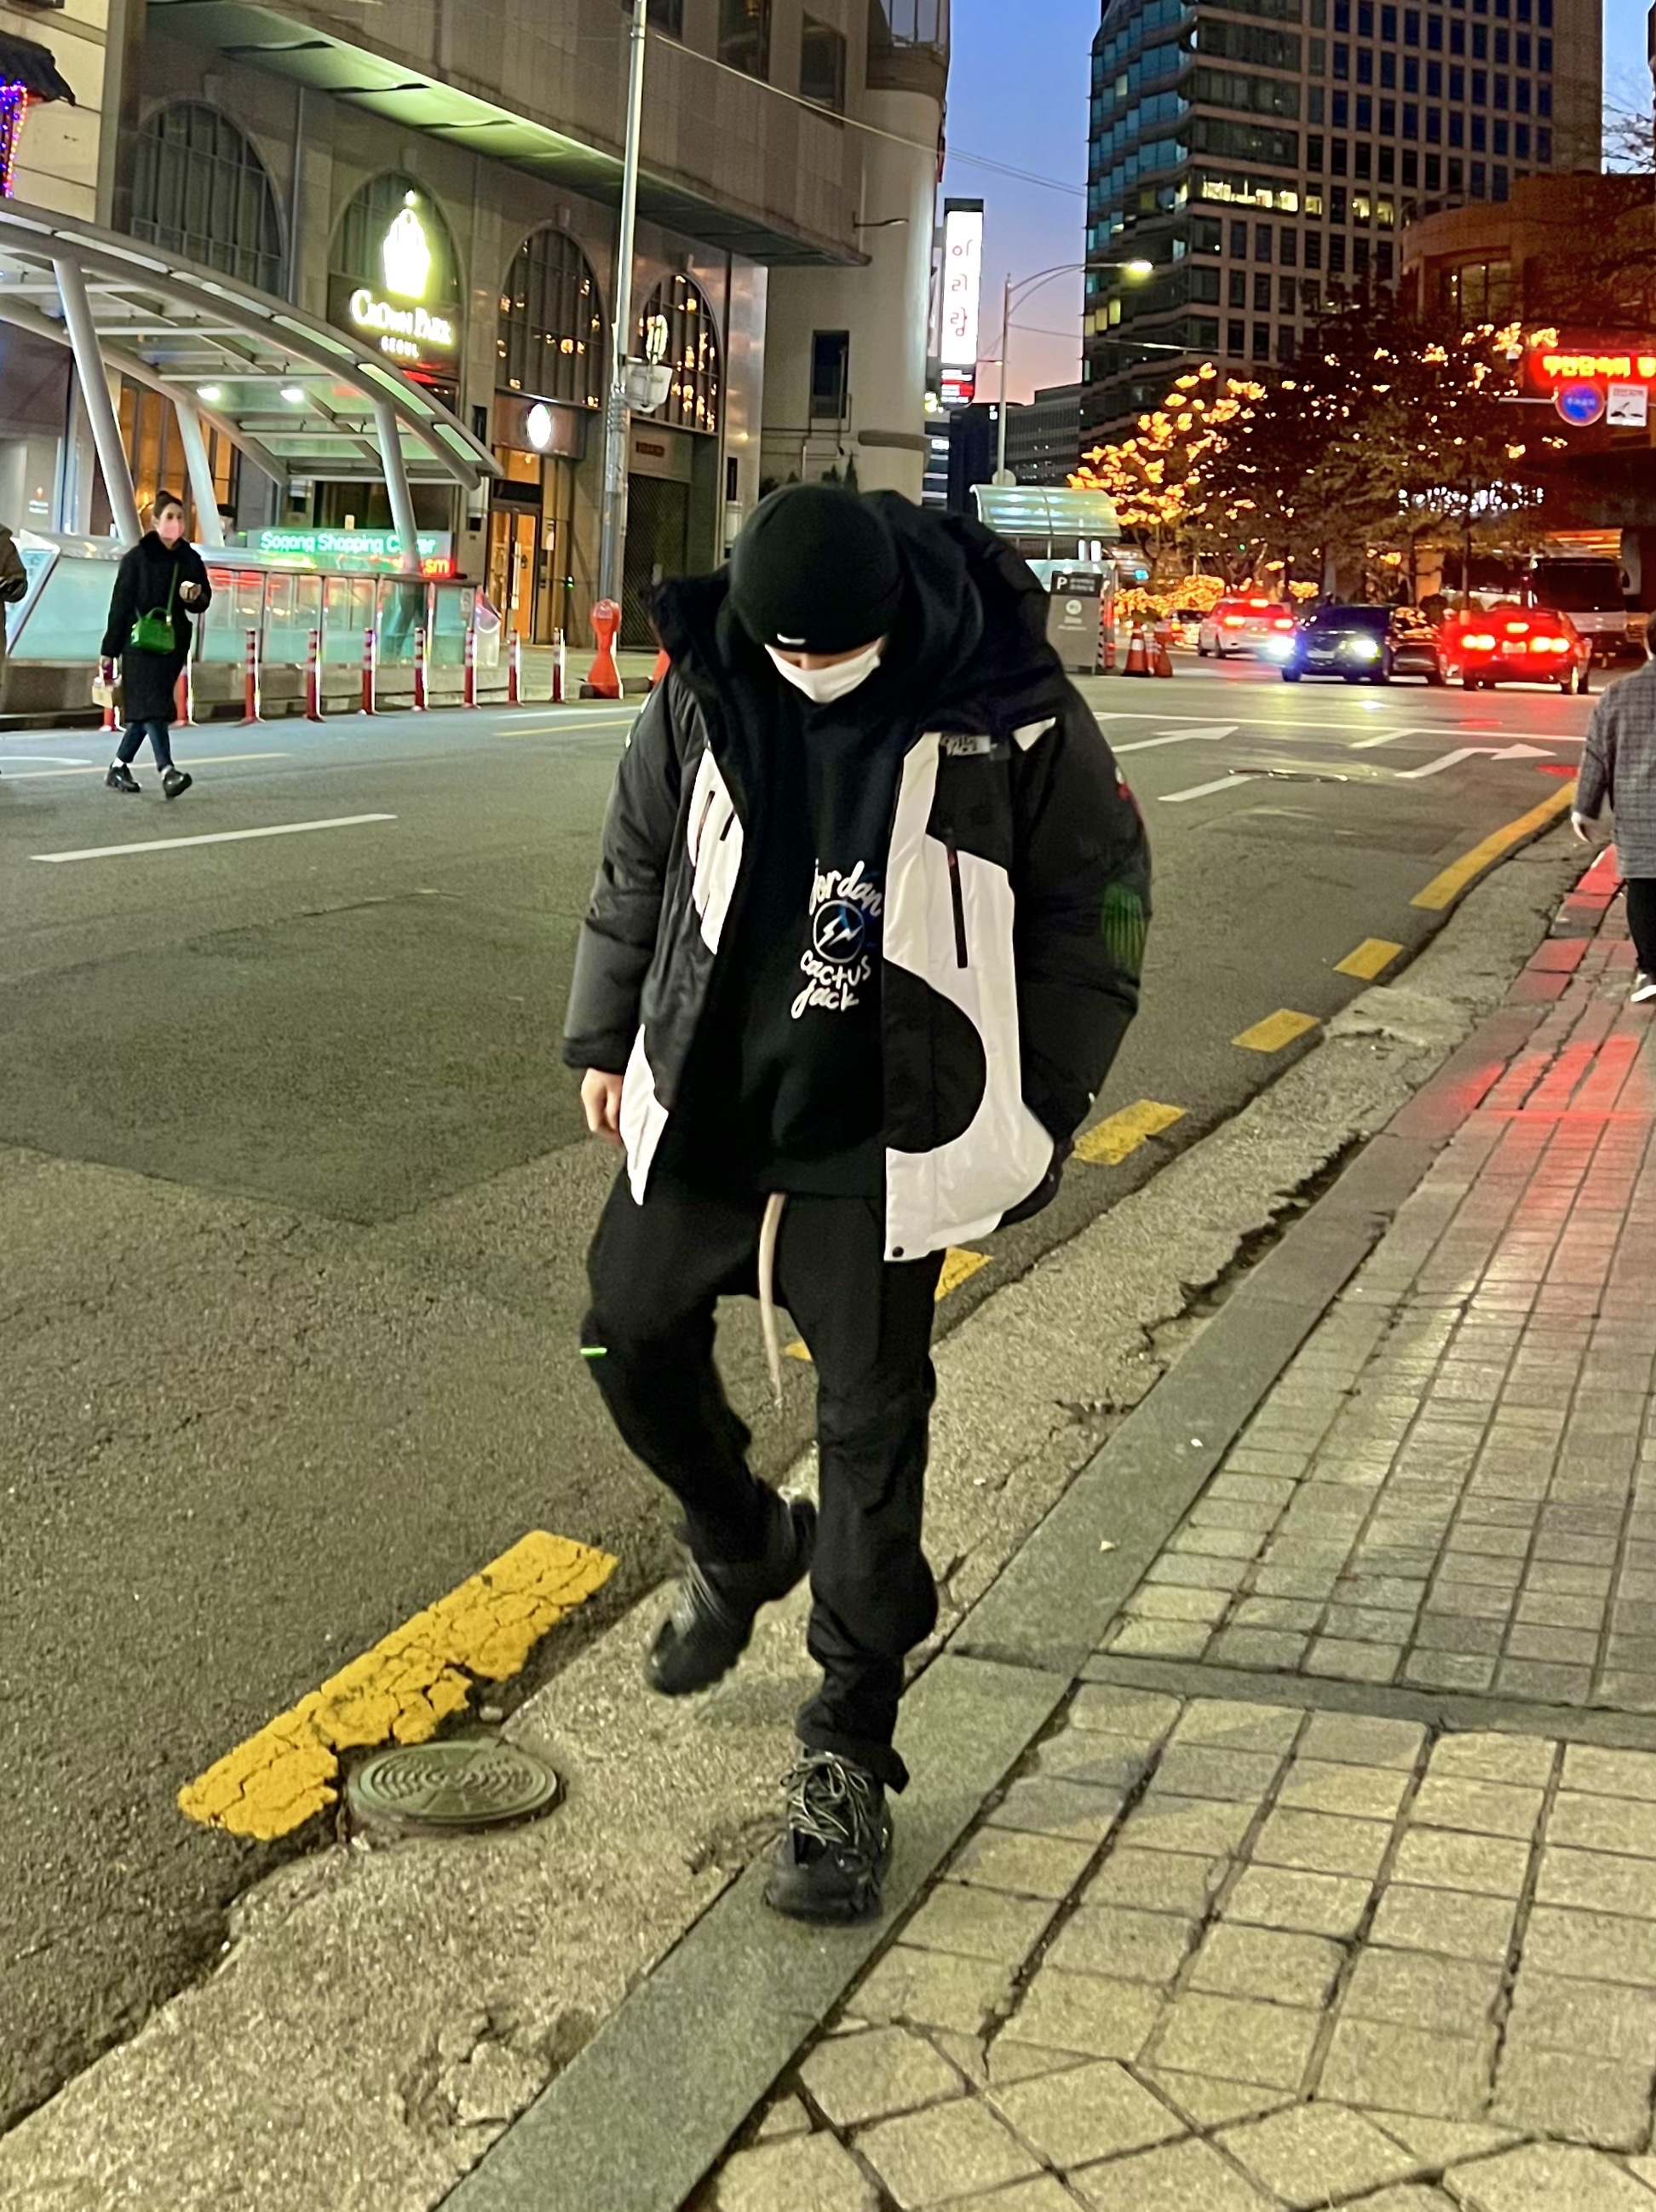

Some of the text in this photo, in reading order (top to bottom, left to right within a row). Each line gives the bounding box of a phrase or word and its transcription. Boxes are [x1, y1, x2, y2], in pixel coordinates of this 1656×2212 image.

[318, 533, 383, 555] Shopping
[1056, 576, 1068, 590] P
[800, 949, 871, 989] cactus
